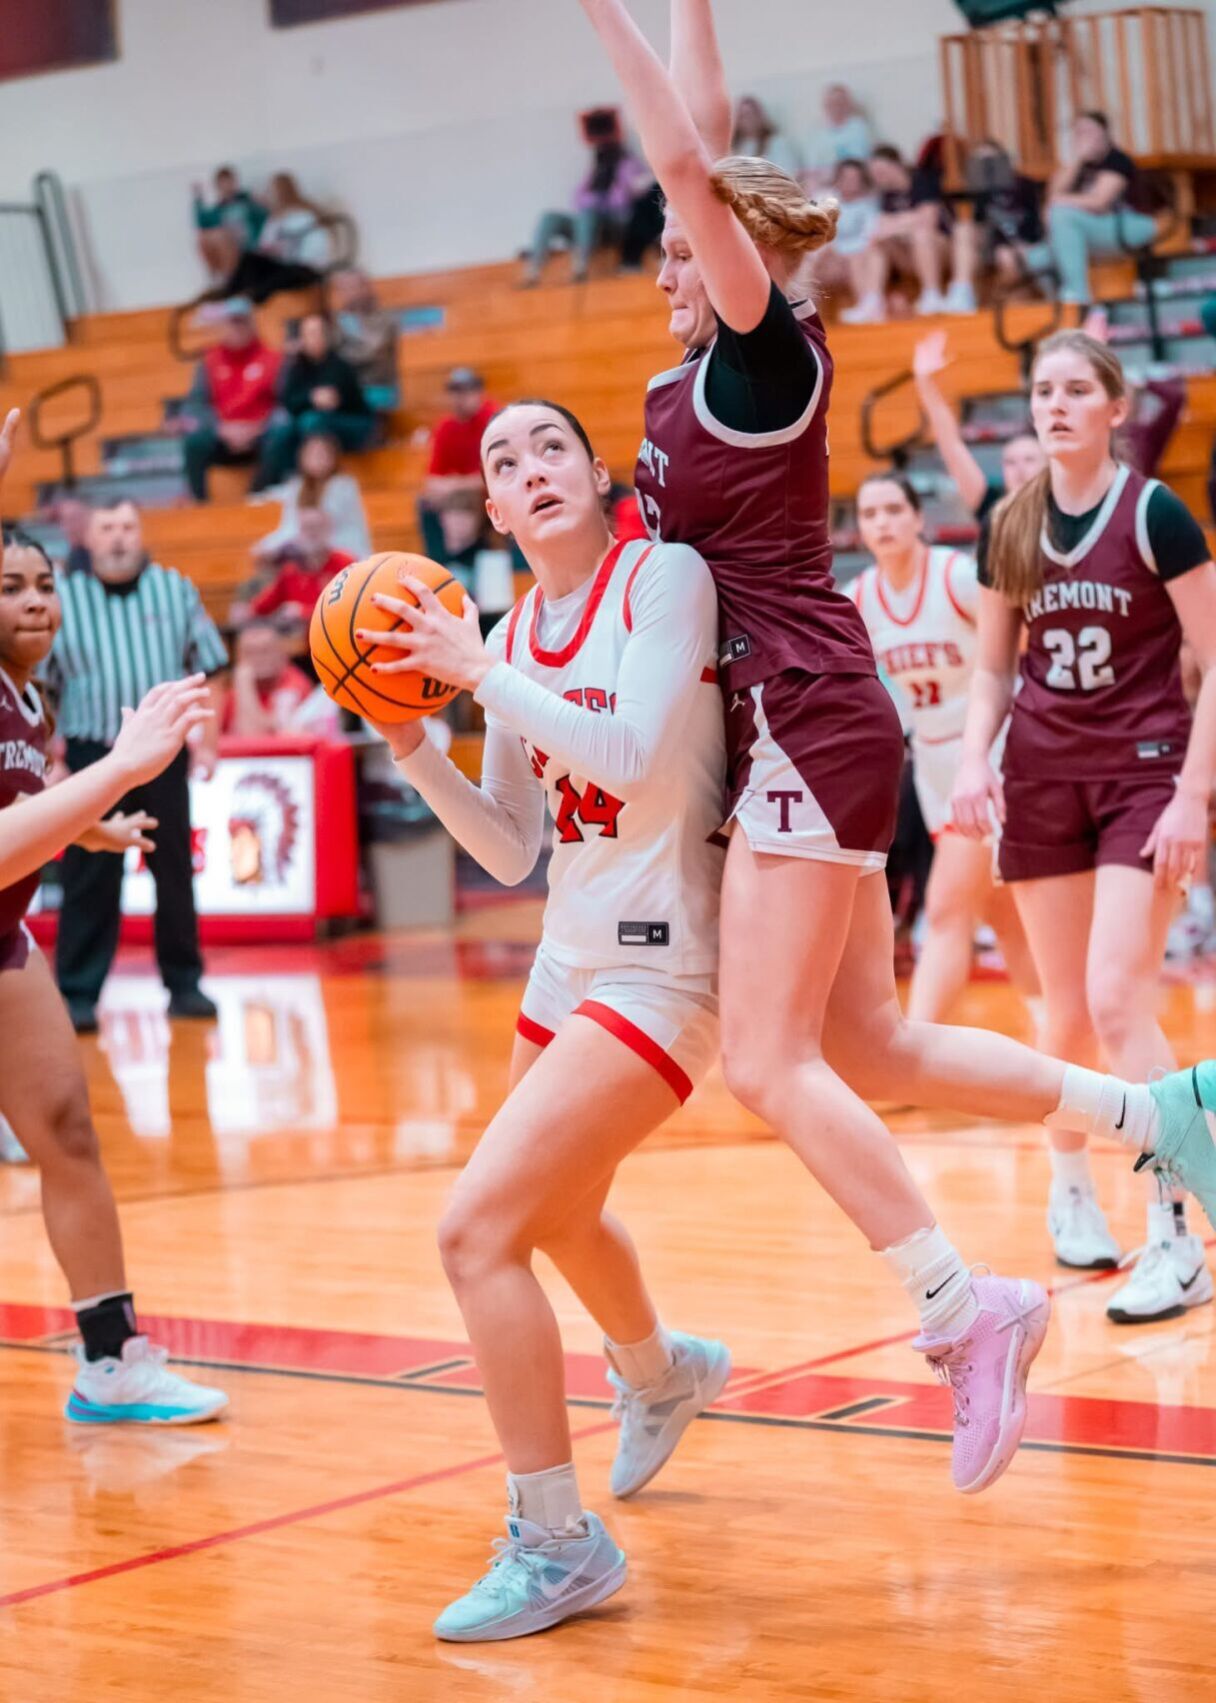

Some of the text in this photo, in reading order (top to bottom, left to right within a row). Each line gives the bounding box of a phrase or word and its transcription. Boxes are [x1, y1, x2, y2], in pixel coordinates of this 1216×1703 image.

[735, 641, 746, 653] M
[1042, 625, 1115, 691] 22
[555, 773, 626, 844] 14
[767, 790, 803, 833] T
[652, 929, 663, 939] M
